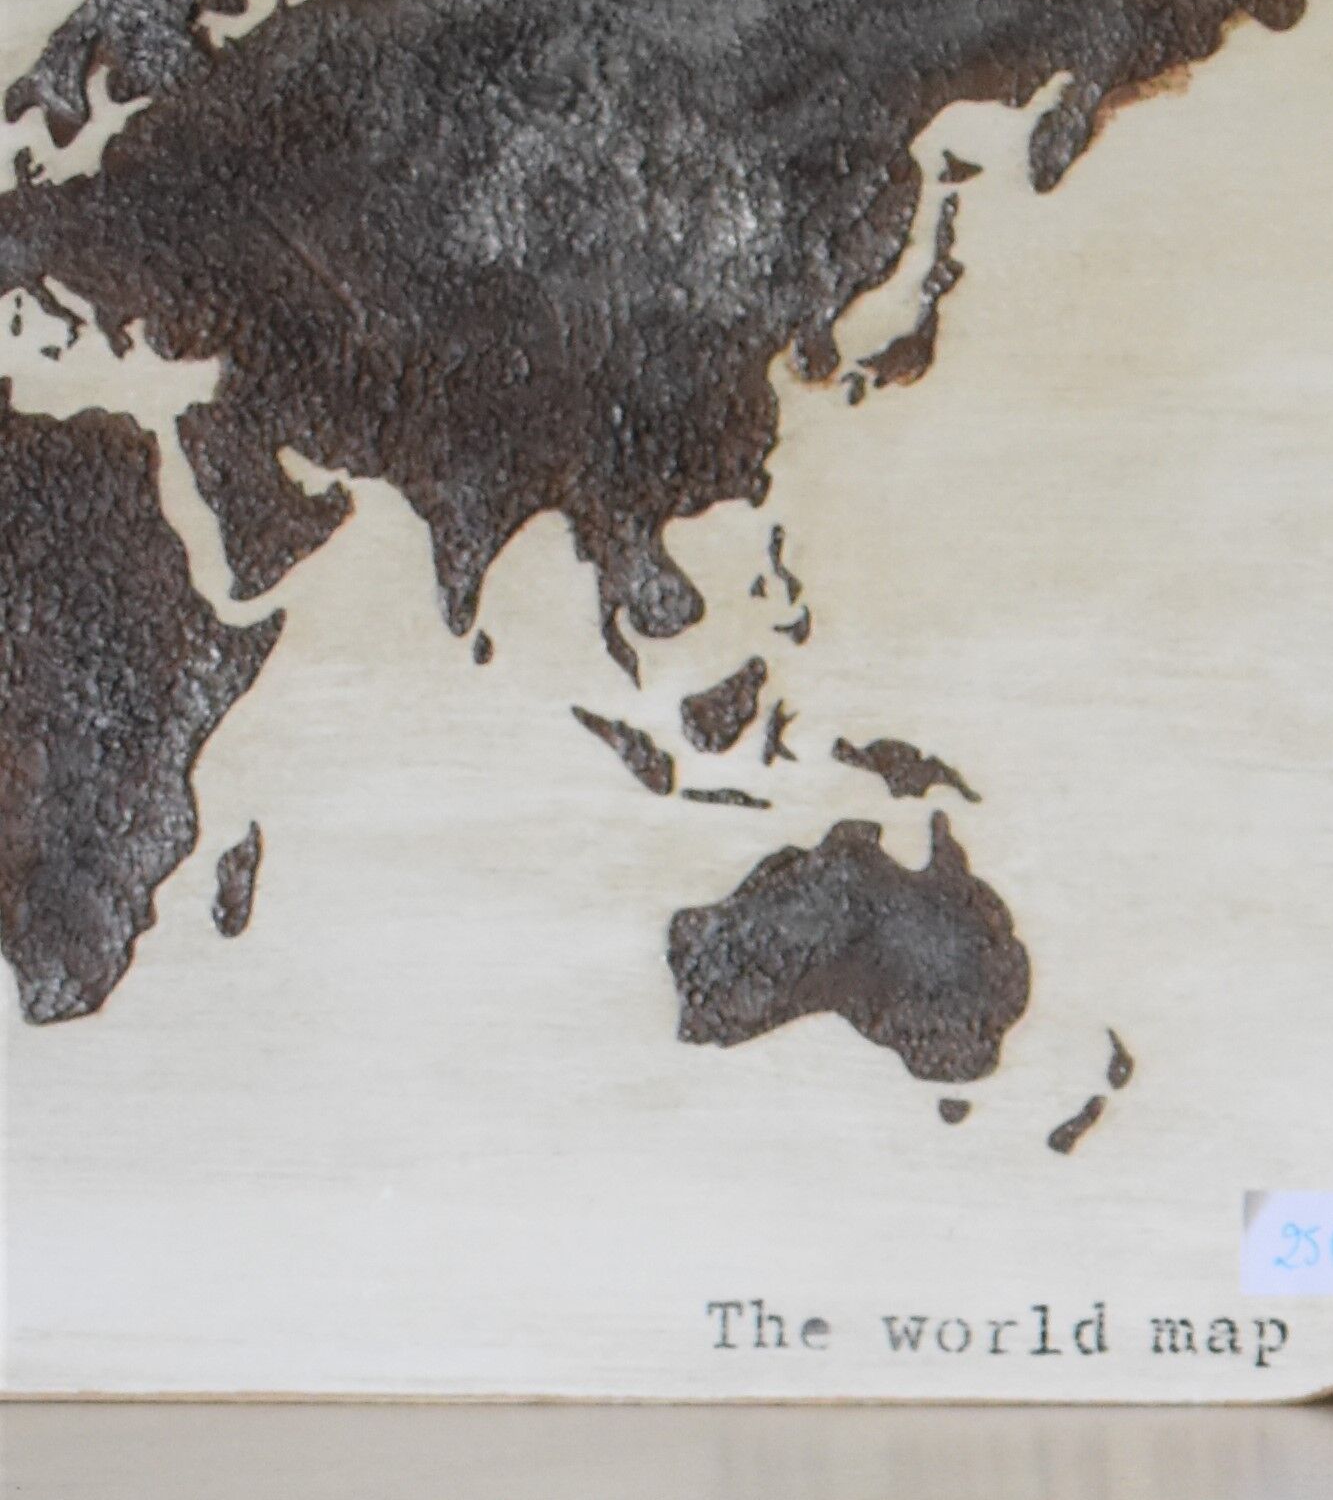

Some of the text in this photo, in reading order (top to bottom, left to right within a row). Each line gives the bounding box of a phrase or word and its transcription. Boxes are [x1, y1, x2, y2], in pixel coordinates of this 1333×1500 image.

[706, 1298, 1289, 1367] The world map
